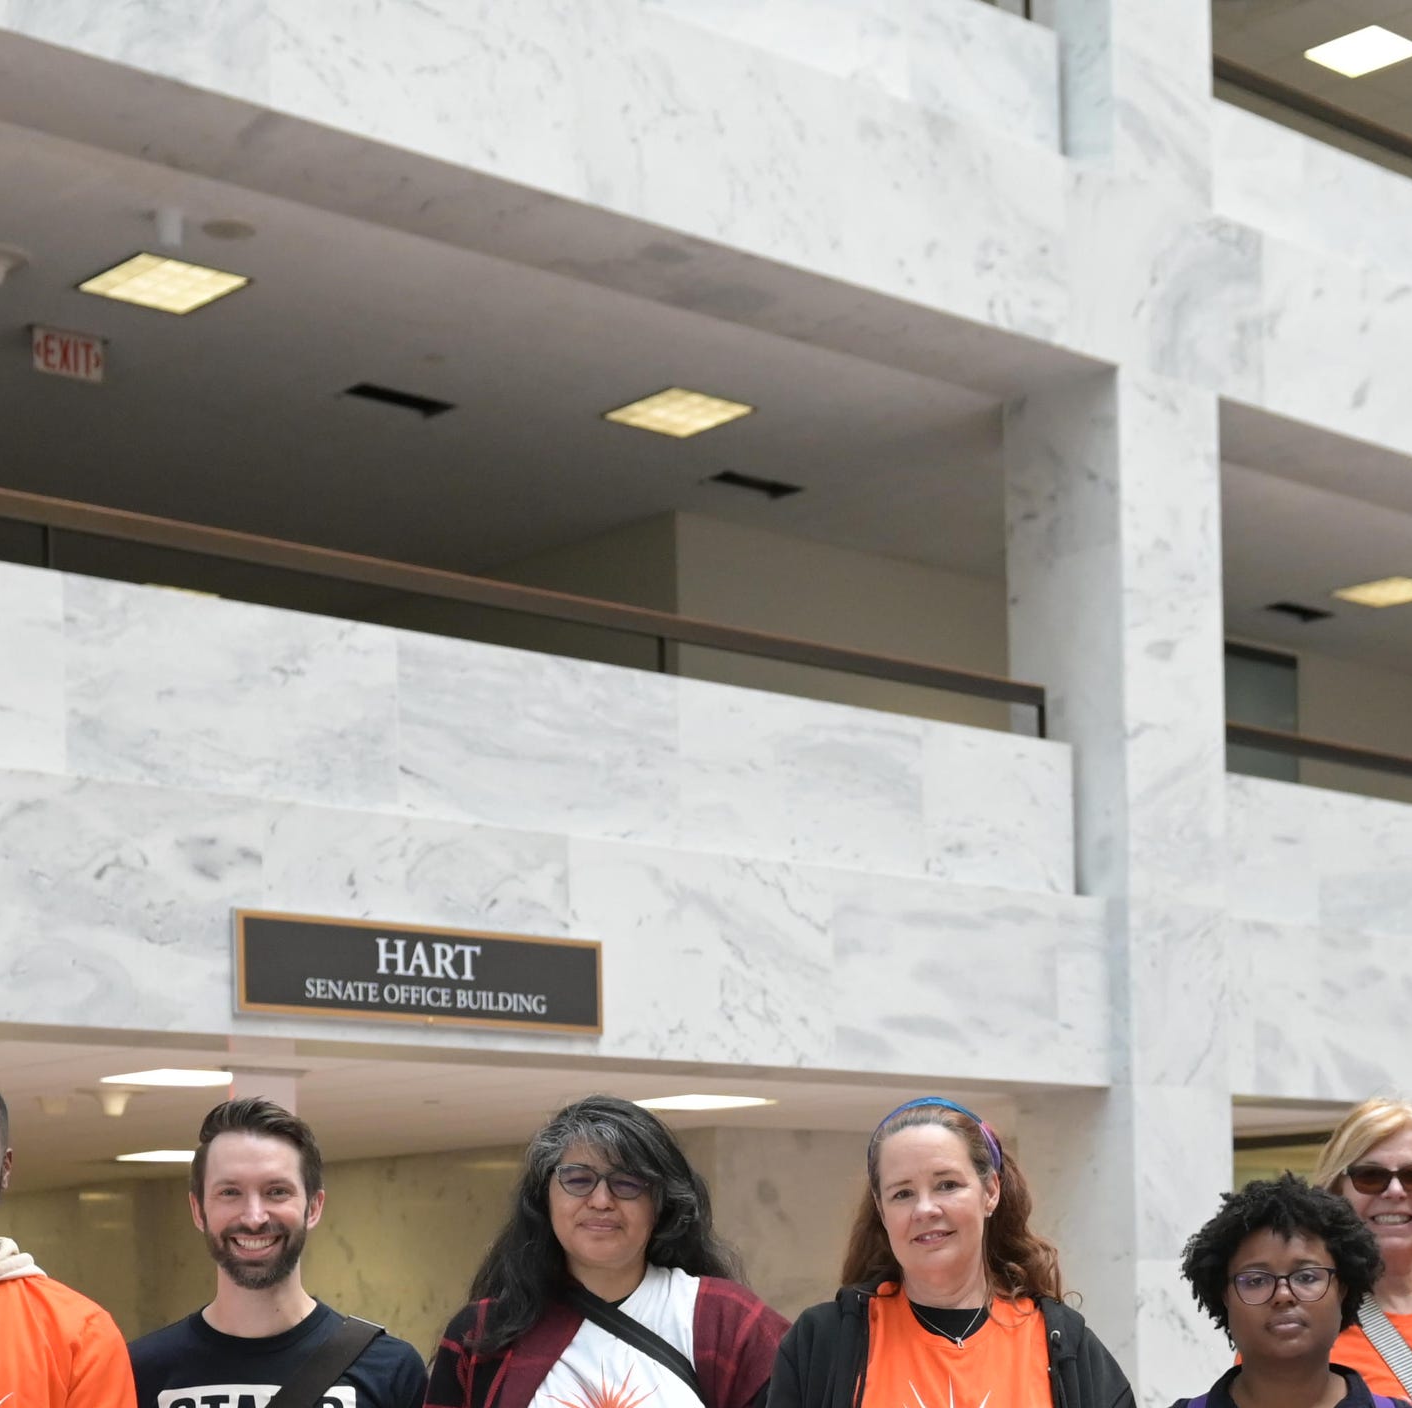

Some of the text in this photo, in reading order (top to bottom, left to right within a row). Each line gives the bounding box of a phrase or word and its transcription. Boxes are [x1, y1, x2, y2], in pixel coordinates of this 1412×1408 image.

[43, 335, 93, 375] EXIT
[375, 937, 481, 980] HART
[305, 978, 547, 1015] SENATE OFFICE BUILDING
